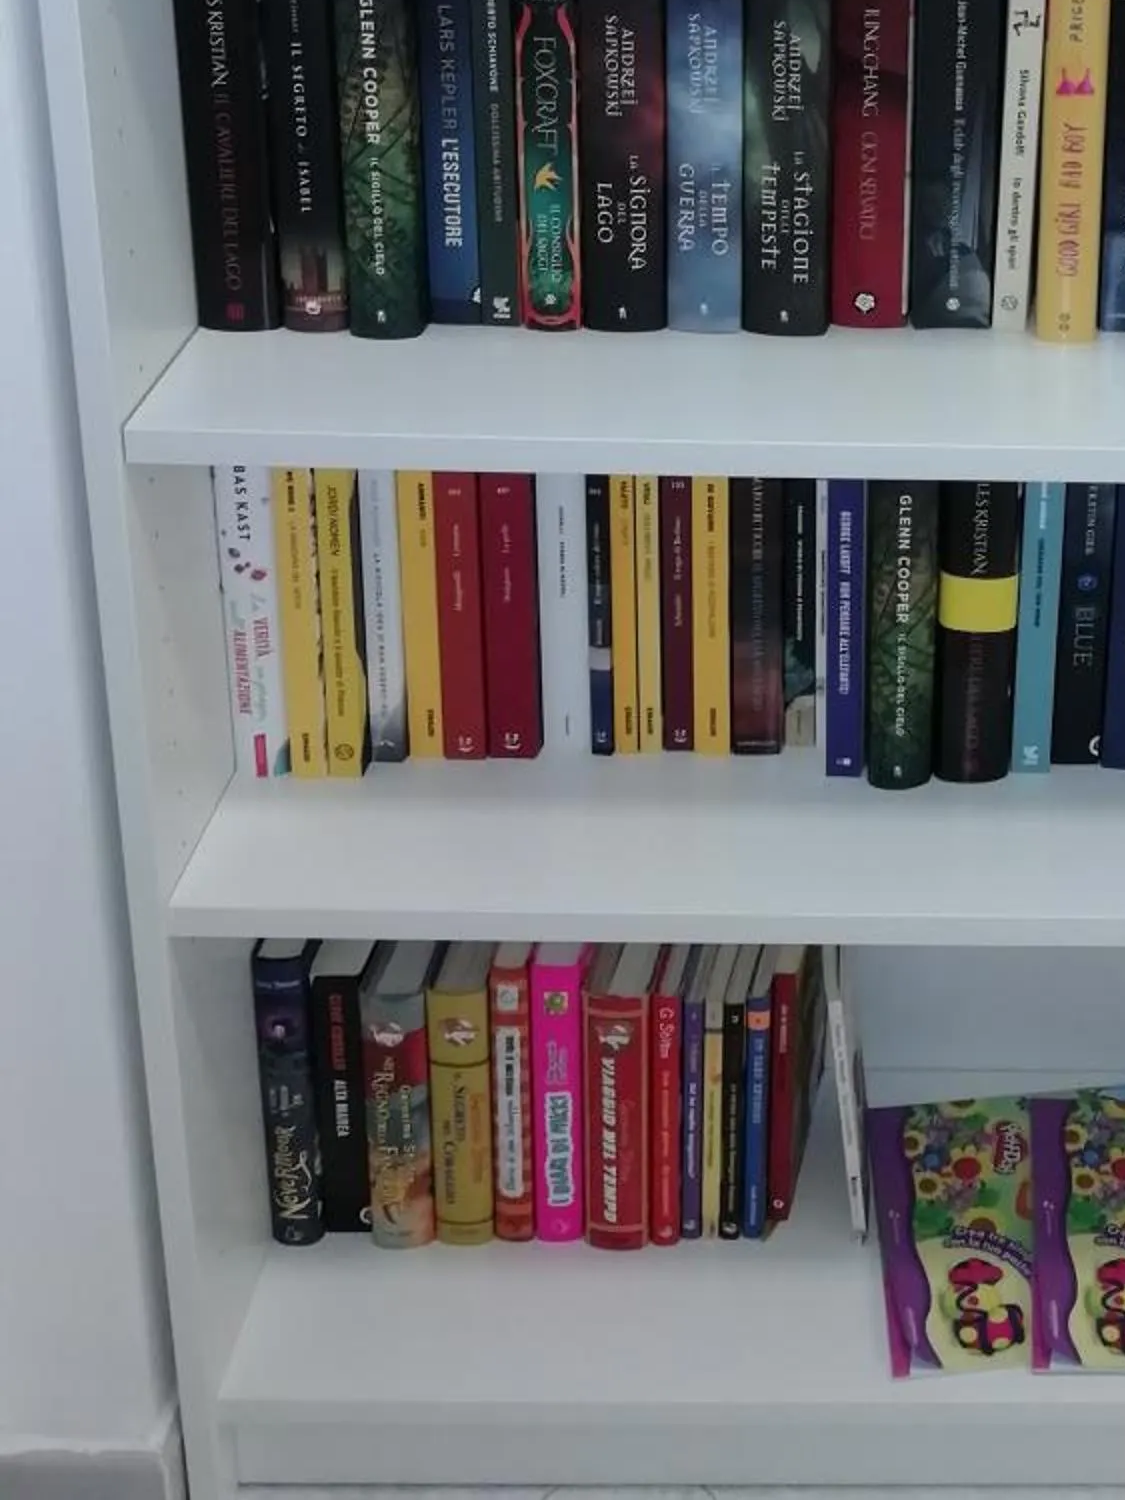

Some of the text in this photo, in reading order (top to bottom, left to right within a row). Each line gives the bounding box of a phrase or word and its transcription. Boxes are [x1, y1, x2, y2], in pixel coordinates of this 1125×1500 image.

[207, 11, 230, 88] KRISTIAN
[291, 42, 303, 57] IL
[437, 4, 457, 130] LARS KEPLER
[487, 32, 500, 93] SCHIAVONE
[604, 14, 623, 118] SAPKOWSKI
[620, 27, 639, 106] ANDRZEJ
[772, 20, 790, 122] SAPKOWSKI
[787, 32, 805, 110] ANDRZEJ
[862, 53, 880, 118] CHANG
[291, 64, 308, 137] SEGRETO
[363, 67, 381, 145] COOPER
[532, 36, 560, 156] FOXCRAFT
[221, 207, 240, 239] DEL
[298, 161, 313, 214] ISABEL
[441, 137, 463, 247] L'ESECUTORE
[596, 182, 615, 243] LAGO
[627, 174, 652, 270] SIGNORA
[678, 163, 697, 252] GUERRA
[711, 180, 732, 256] TEMPO
[761, 161, 782, 271] TEMPESTE
[793, 171, 814, 285] STAGIONE
[223, 243, 243, 291] LAGO
[233, 465, 251, 541] BAS KAST
[969, 482, 992, 576] LES KRISTIAN
[896, 495, 913, 625] GLENN COOPER
[1072, 605, 1097, 668] BLUE
[601, 1057, 616, 1126] VIAGGIO
[603, 1165, 618, 1223] TEMPO
